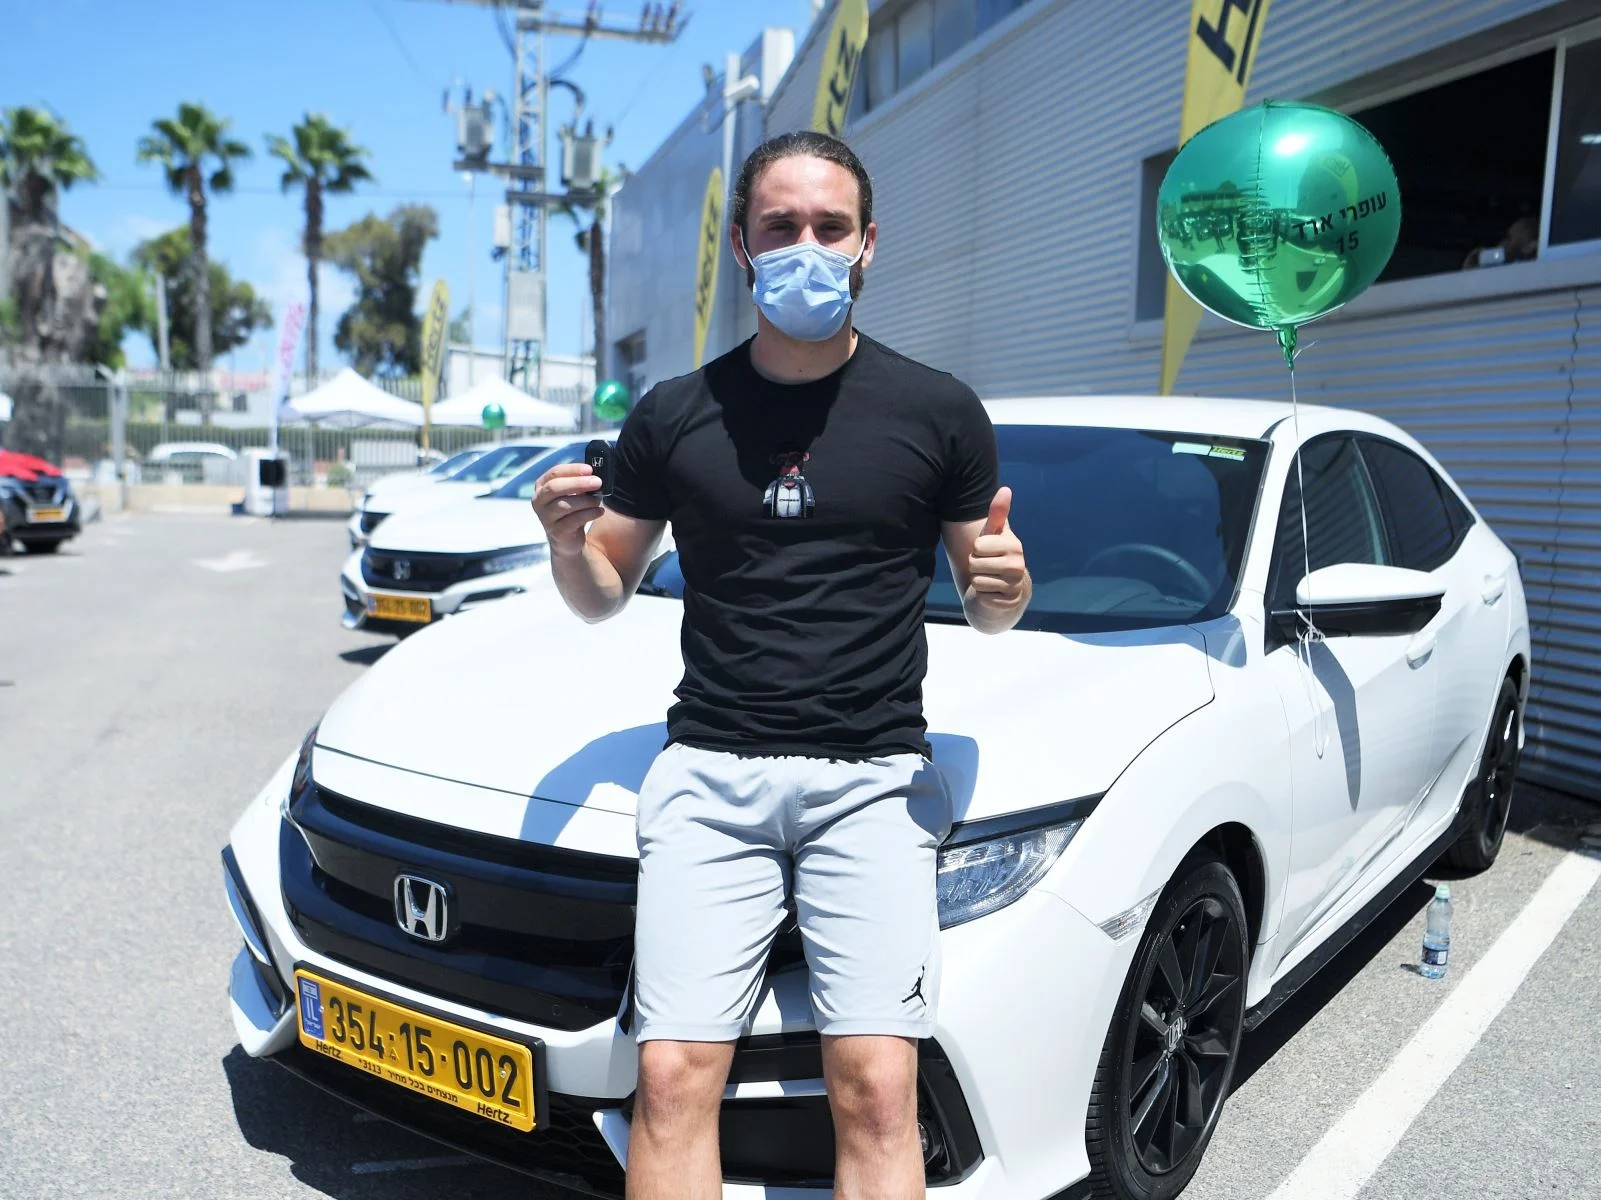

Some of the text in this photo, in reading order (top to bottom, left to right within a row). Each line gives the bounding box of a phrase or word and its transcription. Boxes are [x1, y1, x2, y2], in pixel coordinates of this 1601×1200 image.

[825, 26, 856, 137] rtz
[1339, 191, 1386, 221] עופרי
[1336, 230, 1360, 255] 15
[306, 997, 318, 1021] IL
[388, 1070, 406, 1083] מחיר
[409, 1077, 425, 1090] בכל
[427, 1087, 458, 1102] מנצחים
